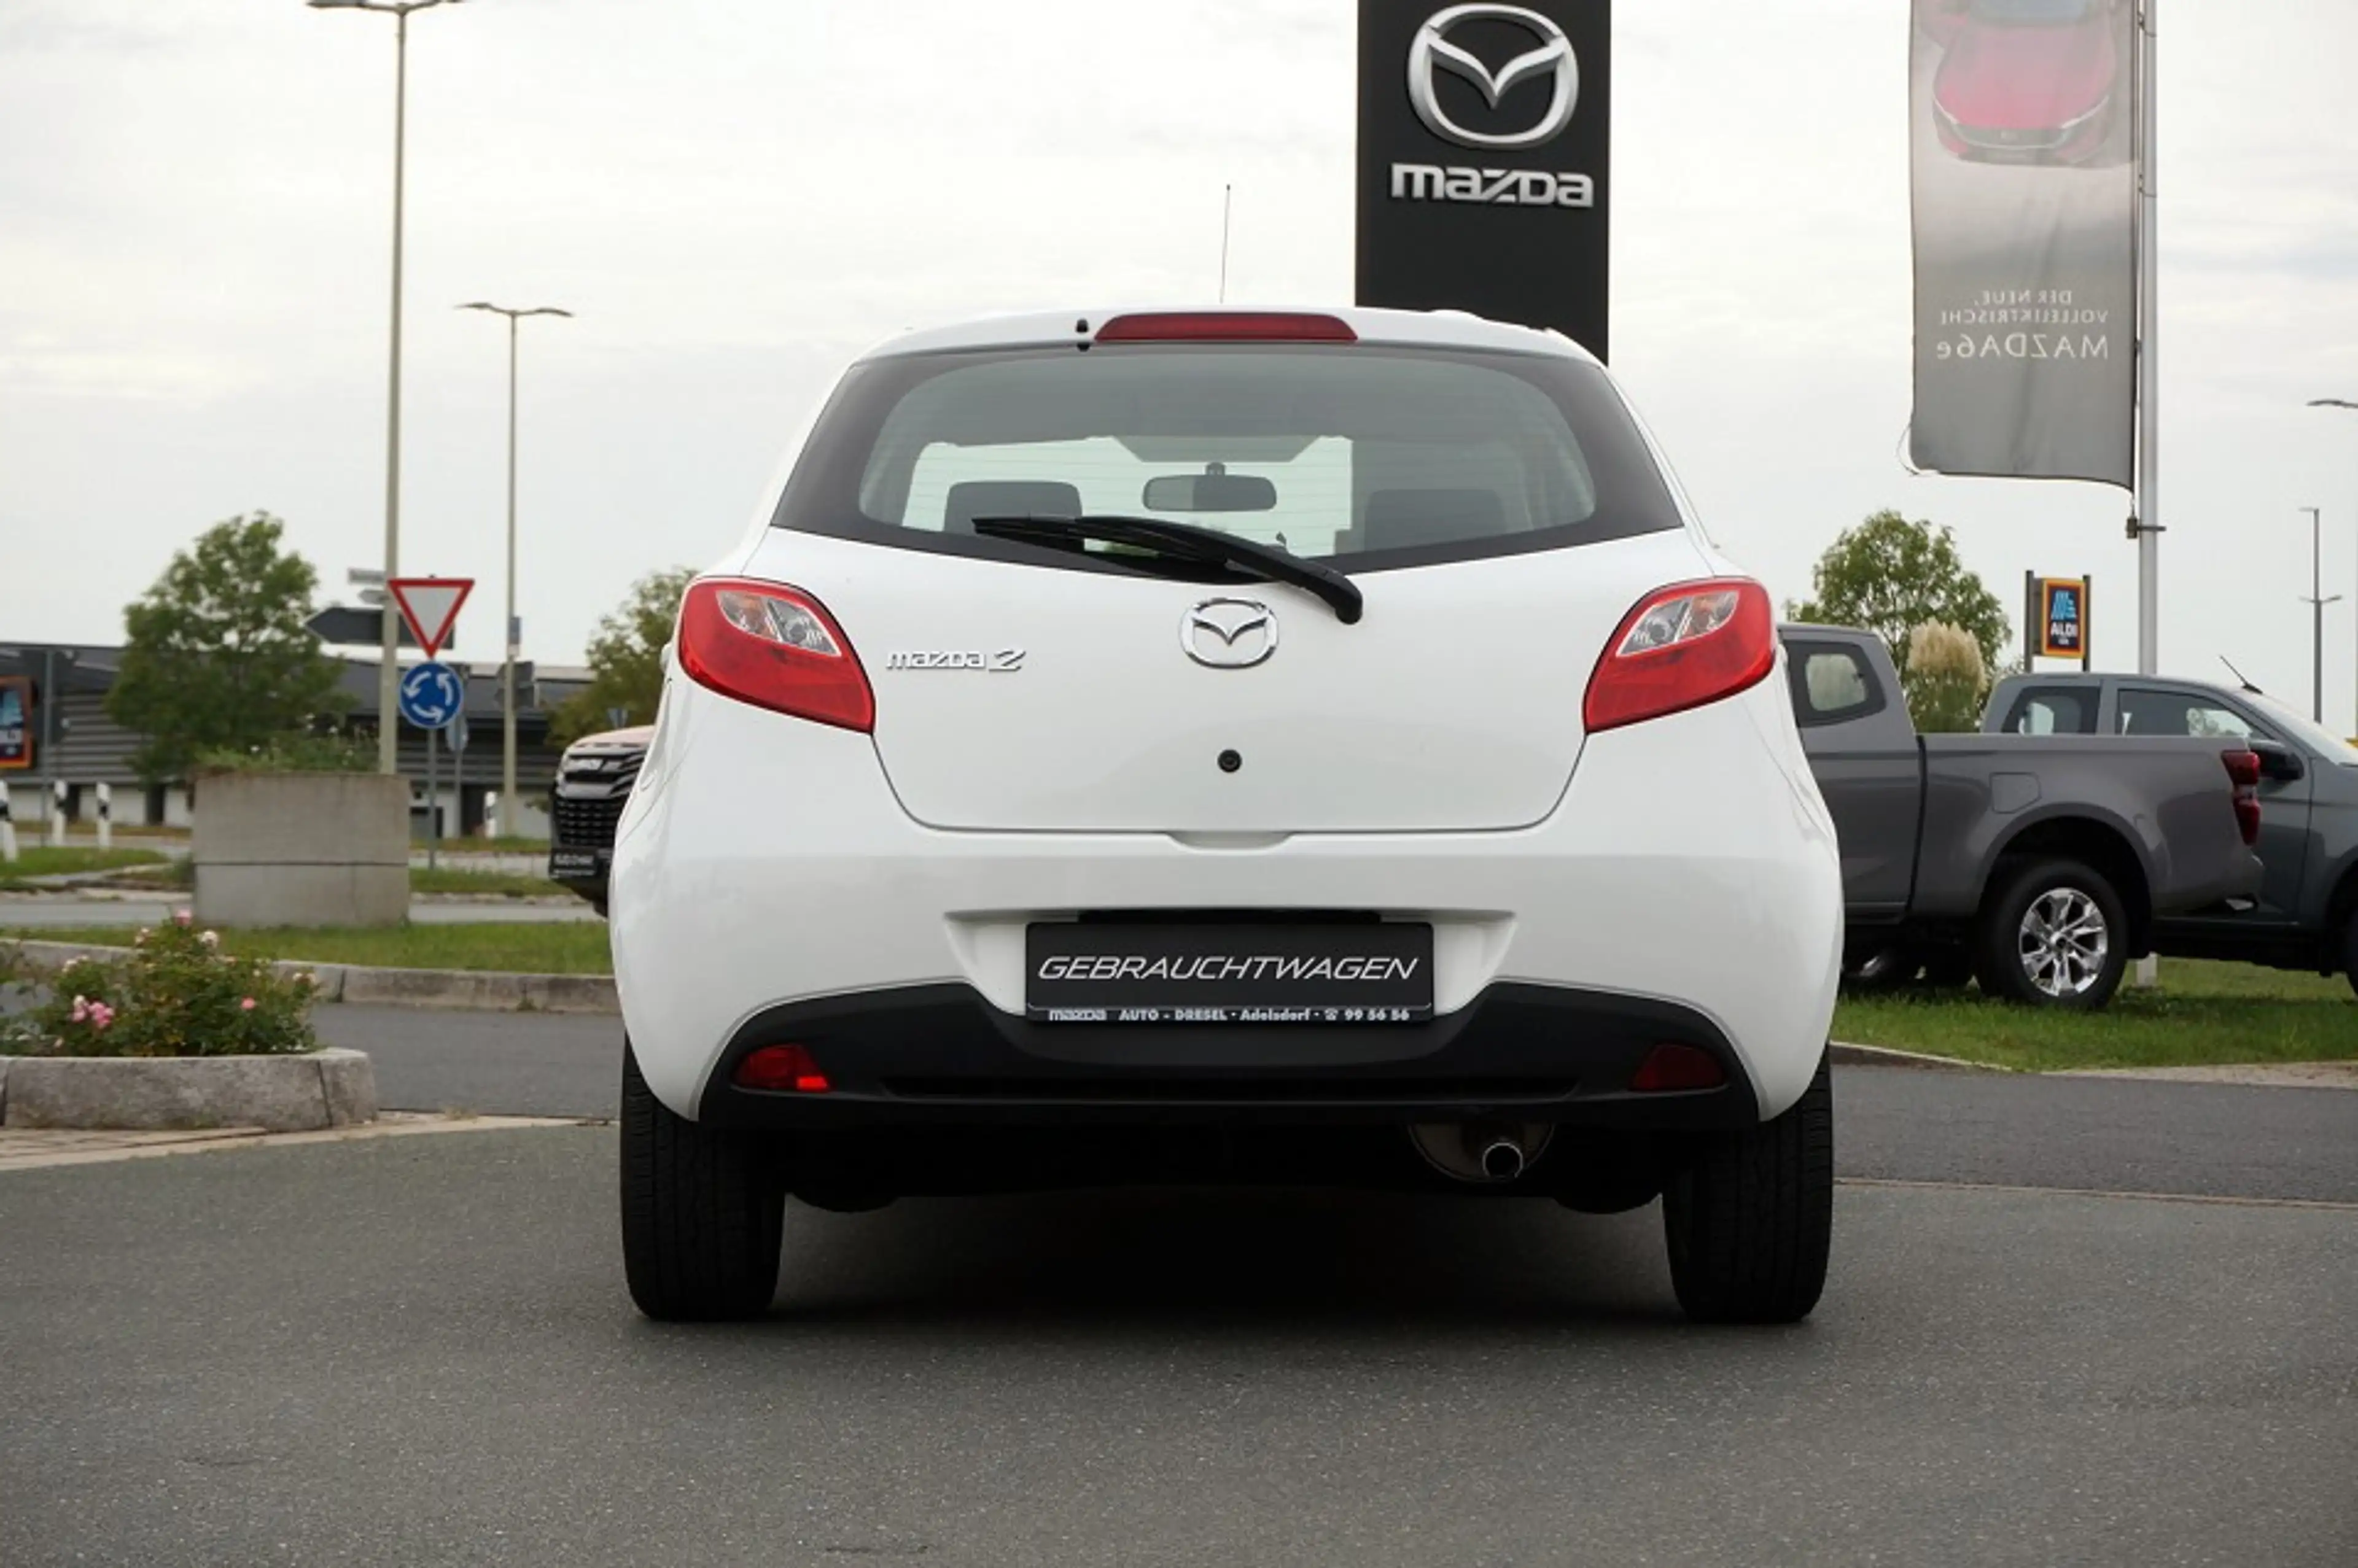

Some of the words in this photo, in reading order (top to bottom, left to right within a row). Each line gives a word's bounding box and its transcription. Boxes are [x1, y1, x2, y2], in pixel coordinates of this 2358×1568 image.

[2050, 621, 2078, 637] ALDI
[988, 648, 1026, 673] 2
[1038, 956, 1419, 980] GEBRAUCHTWAGEN
[1118, 1008, 1159, 1021] AUTO
[1174, 1008, 1228, 1021] DRESEL
[1239, 1007, 1310, 1021] Adelsdorf
[1345, 1009, 1363, 1021] 99
